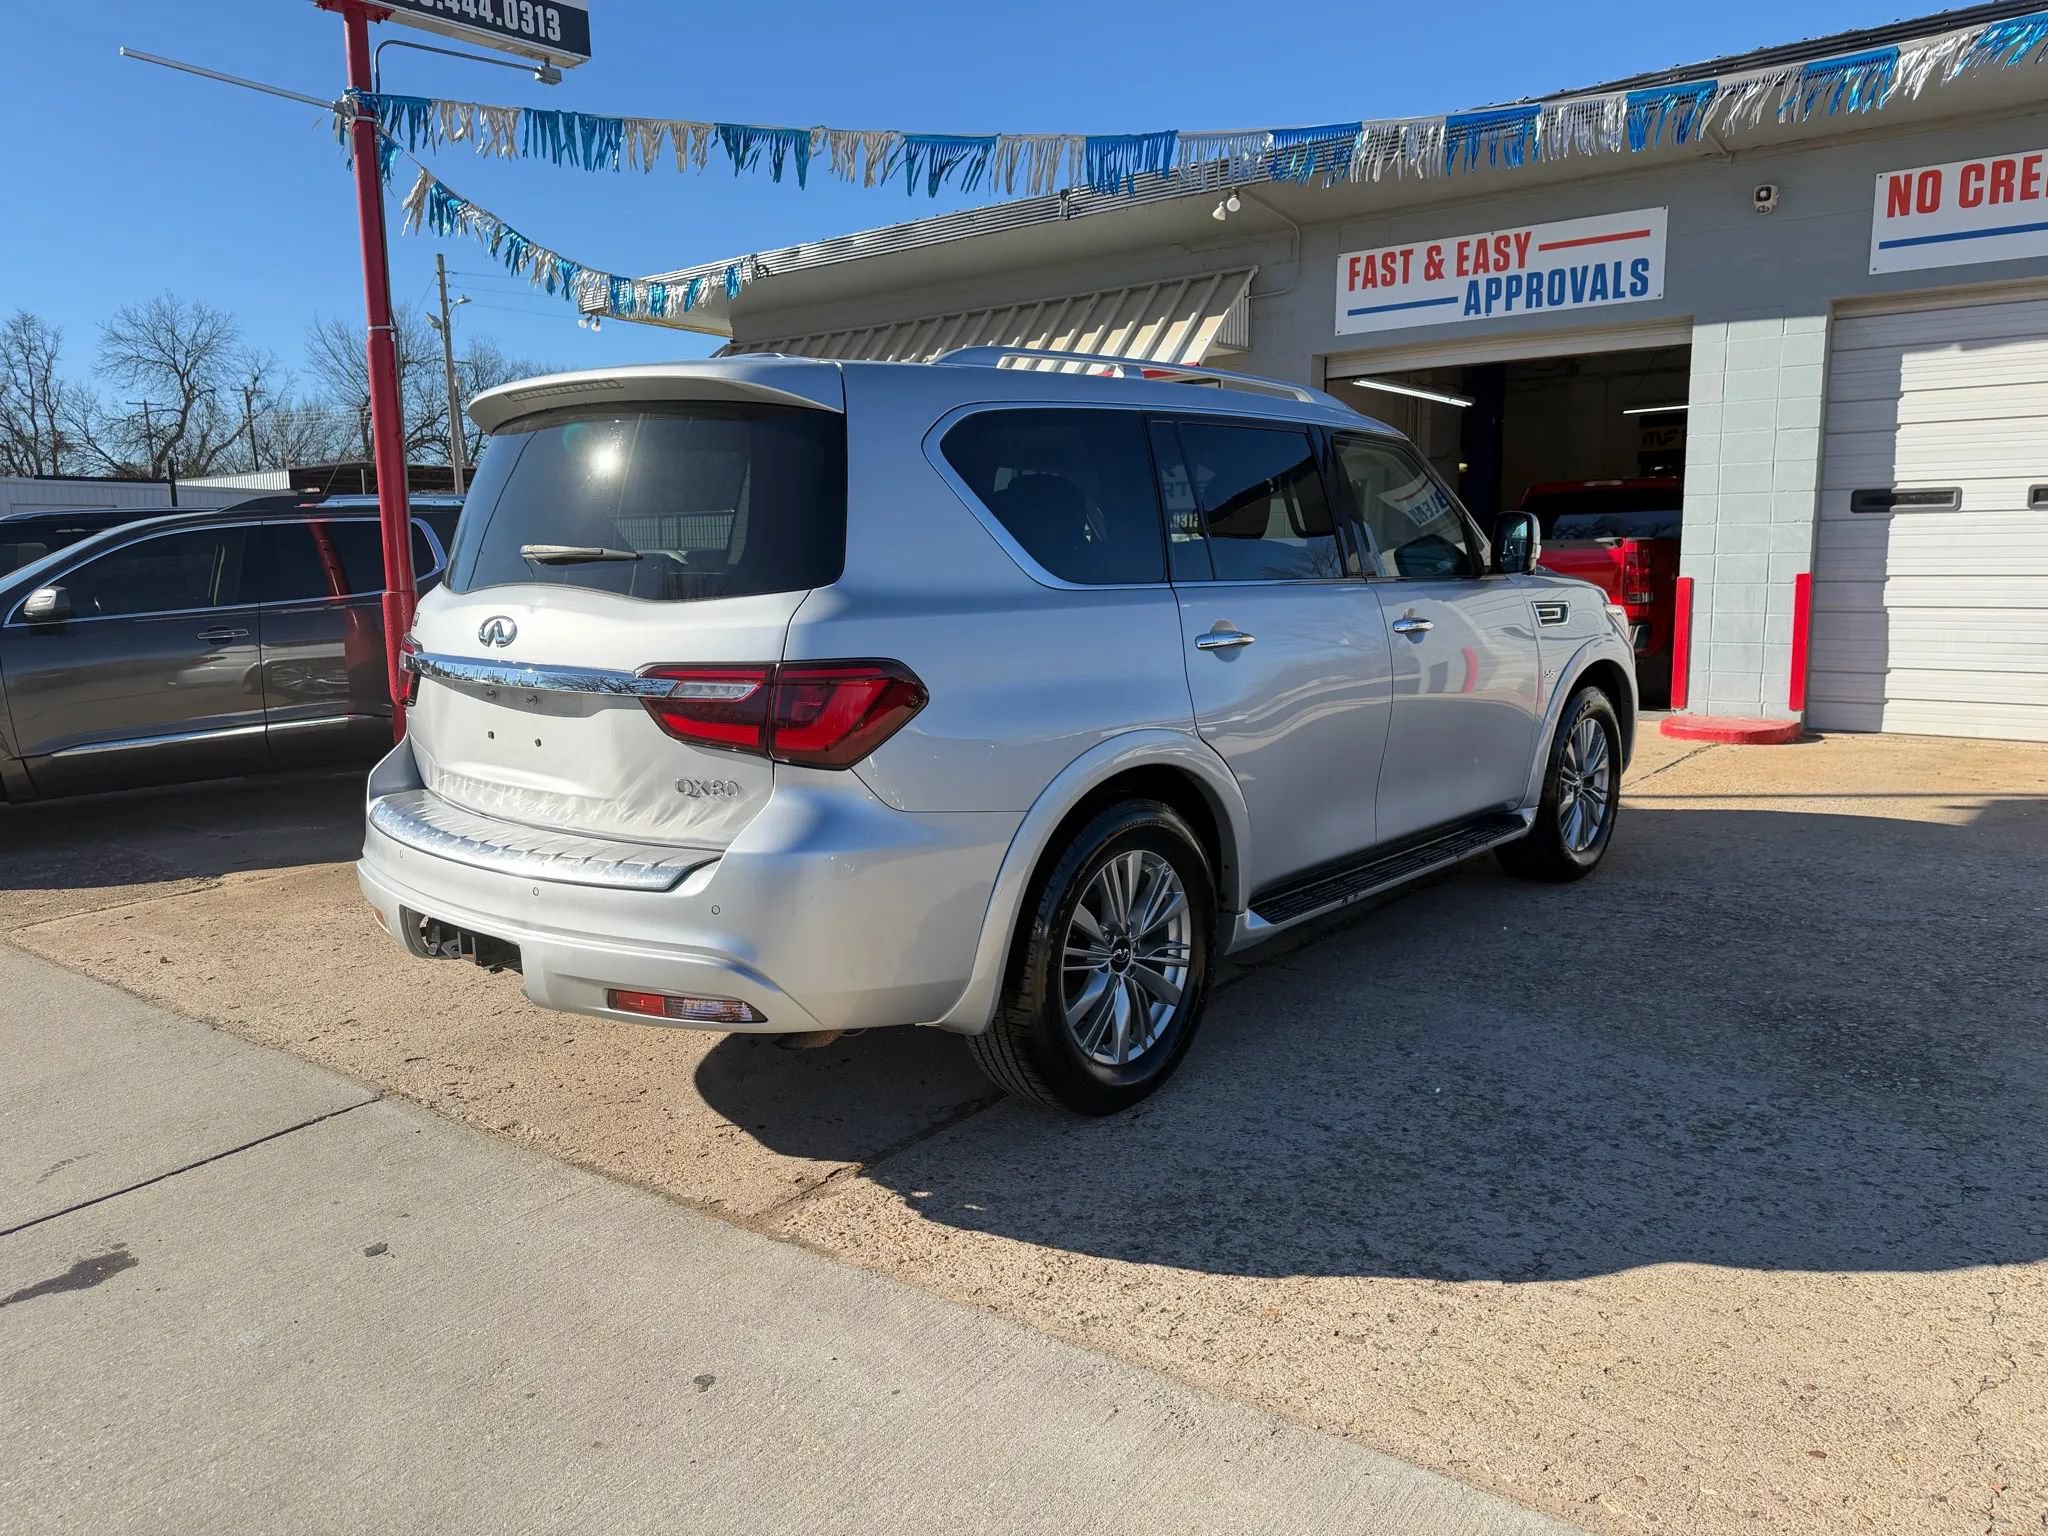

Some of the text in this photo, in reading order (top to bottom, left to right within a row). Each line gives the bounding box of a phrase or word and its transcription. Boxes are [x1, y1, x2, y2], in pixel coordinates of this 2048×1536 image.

[1886, 154, 2048, 218] NO CRE
[1348, 231, 1532, 292] FAST & EASY
[1463, 258, 1650, 316] APPROVALS
